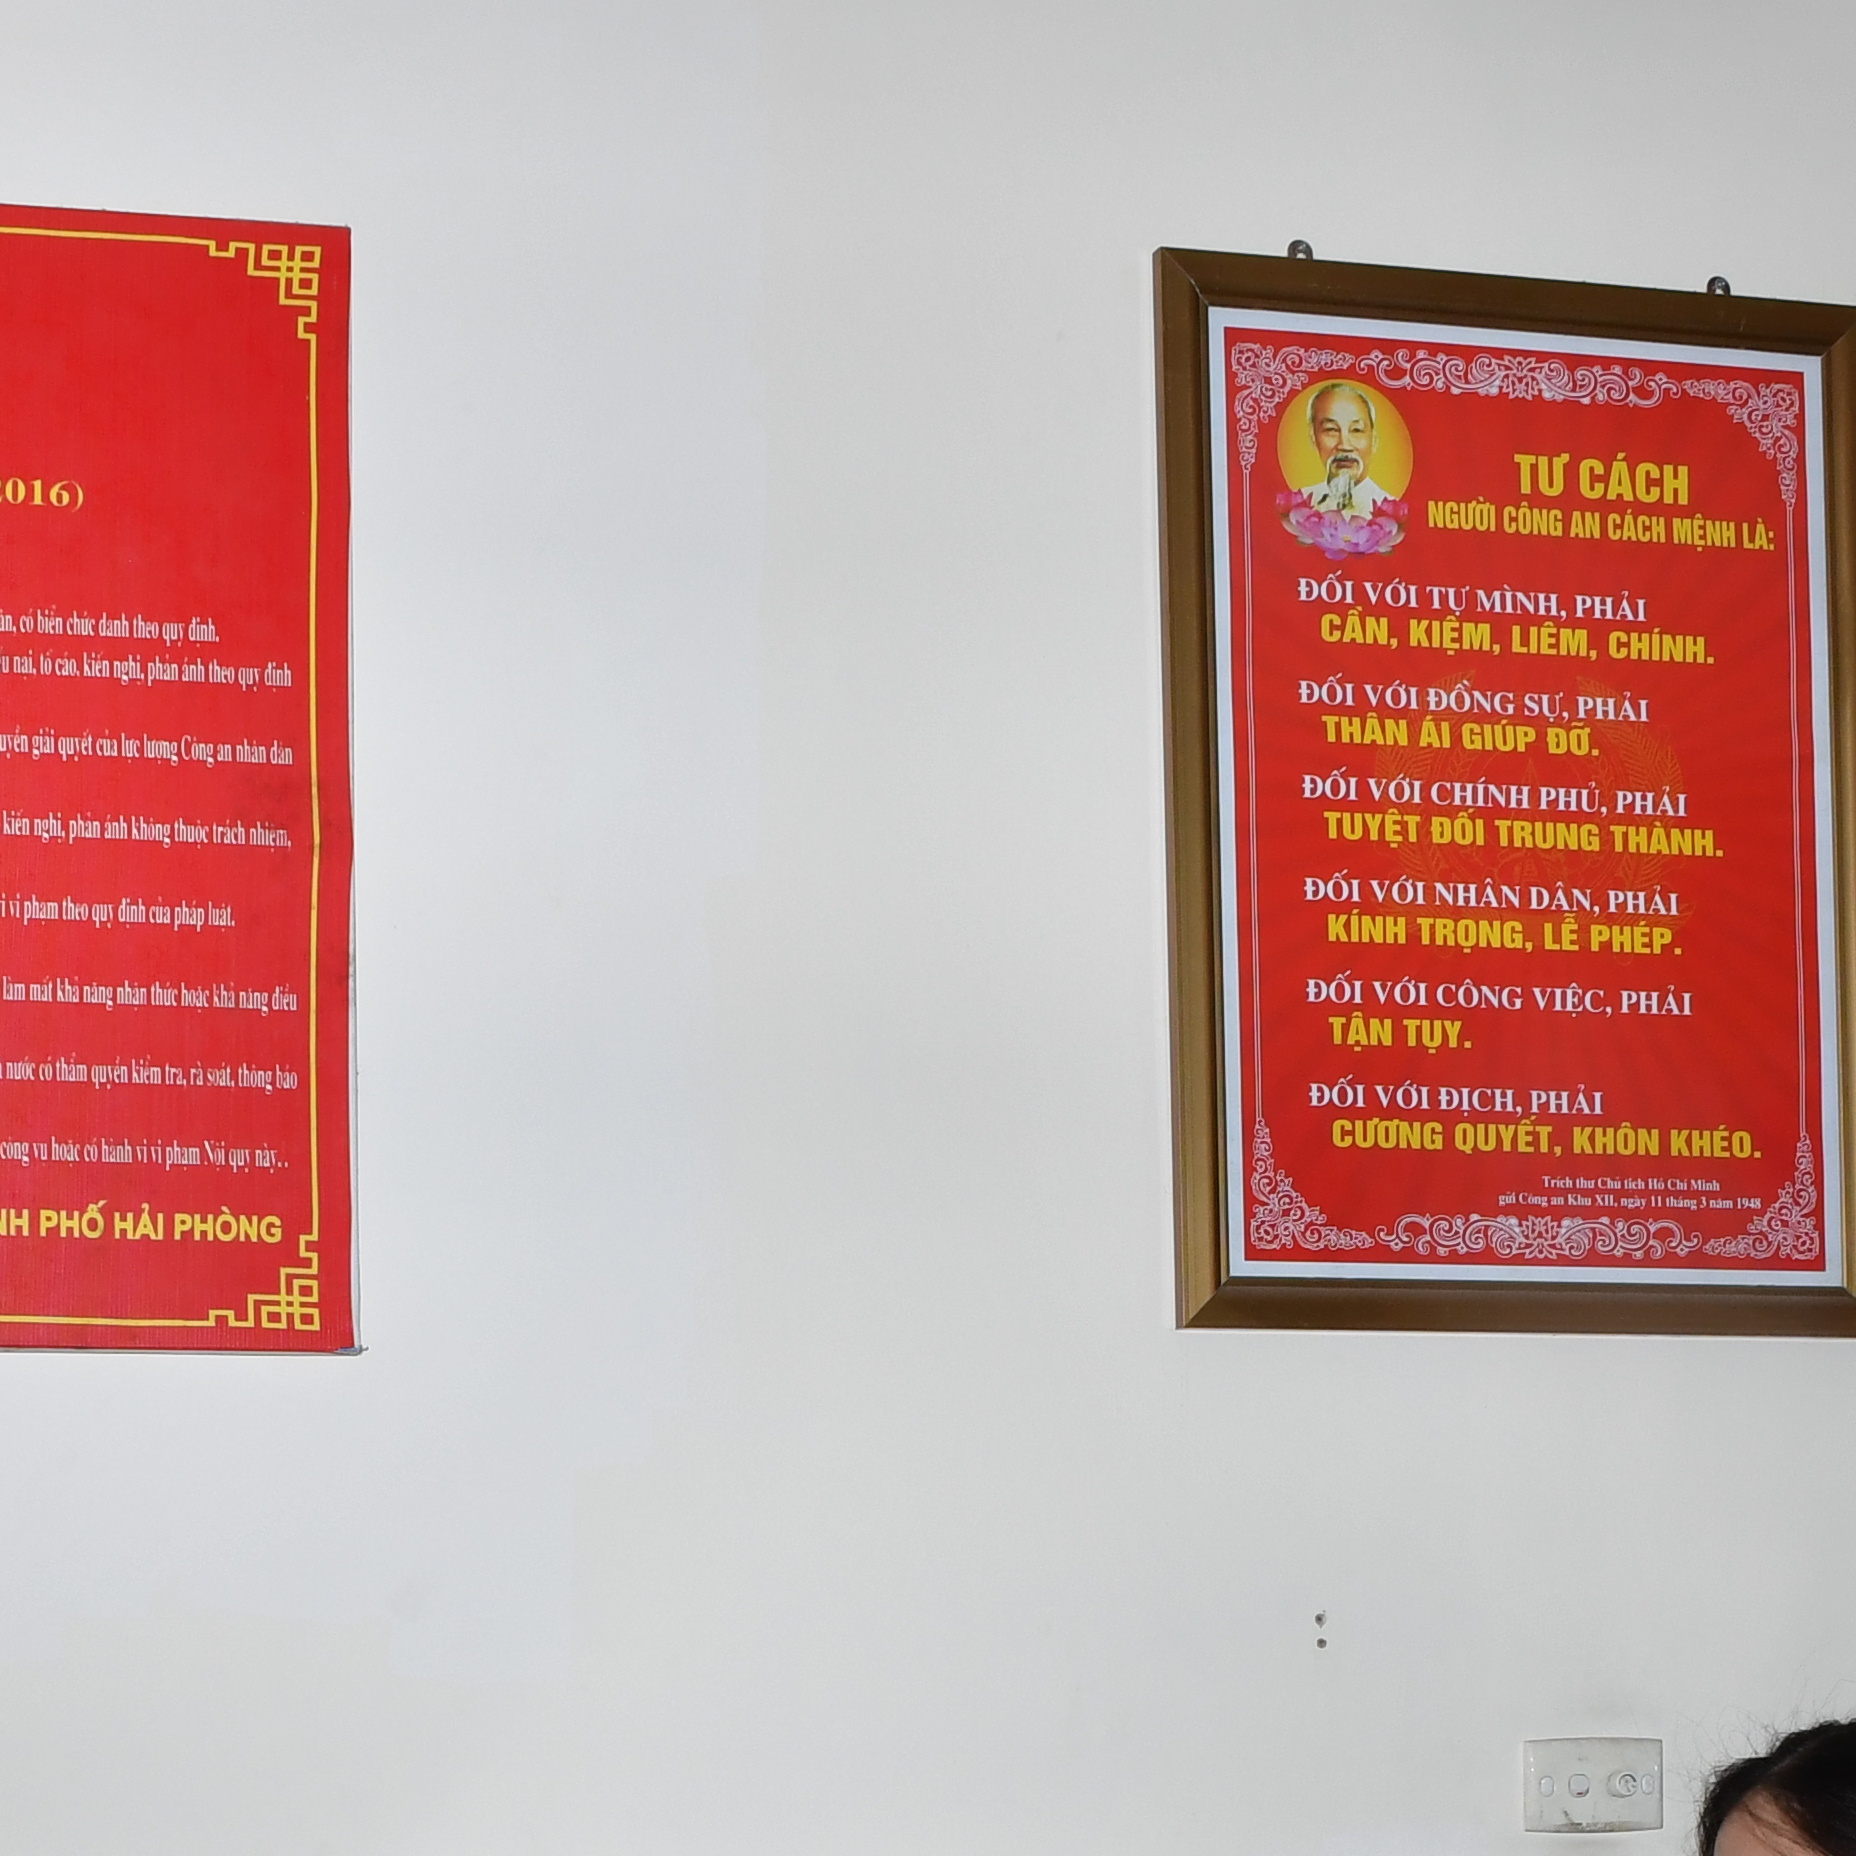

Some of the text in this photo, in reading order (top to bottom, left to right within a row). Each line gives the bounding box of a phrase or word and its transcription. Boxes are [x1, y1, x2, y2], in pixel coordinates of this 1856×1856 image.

[1513, 452, 1689, 506] TƯ CÁCH
[1427, 500, 1775, 551] NGƯỜI CÔNG AN CÁCH MỆNH LÀ:
[1297, 573, 1647, 622] ĐỐI VỚI TỰ MÌNH, PHẢI
[1320, 607, 1715, 665] CẦN, KIỆM, LIÊM, CHÍNH.
[1298, 675, 1649, 722] ĐỐI VỚI ĐỒNG SỰ, PHẢI
[1321, 712, 1600, 757] THÂN ÁI GIÚP ĐỠ.
[1301, 768, 1687, 817] ĐỐI VỚI CHÍNH PHỦ, PHẢI
[1323, 807, 1724, 857] TUYỆT ĐỐI TRUNG THÀNH.
[1327, 910, 1682, 955] KÍNH TRỌNG, LỄ PHÉP.
[1328, 1012, 1472, 1054] TẬN TỤY.
[1308, 1076, 1604, 1118] ĐỐI VỚI ĐỊCH, PHẢI
[1332, 1117, 1762, 1159] CƯƠNG QUYẾT, KHÔN KHÉO.
[1541, 1175, 1573, 1189] Trích
[1690, 1178, 1721, 1192] Minh
[39, 1199, 107, 1239] PHỐ
[113, 1202, 164, 1241] HẢI
[173, 1205, 282, 1244] PHÒNG
